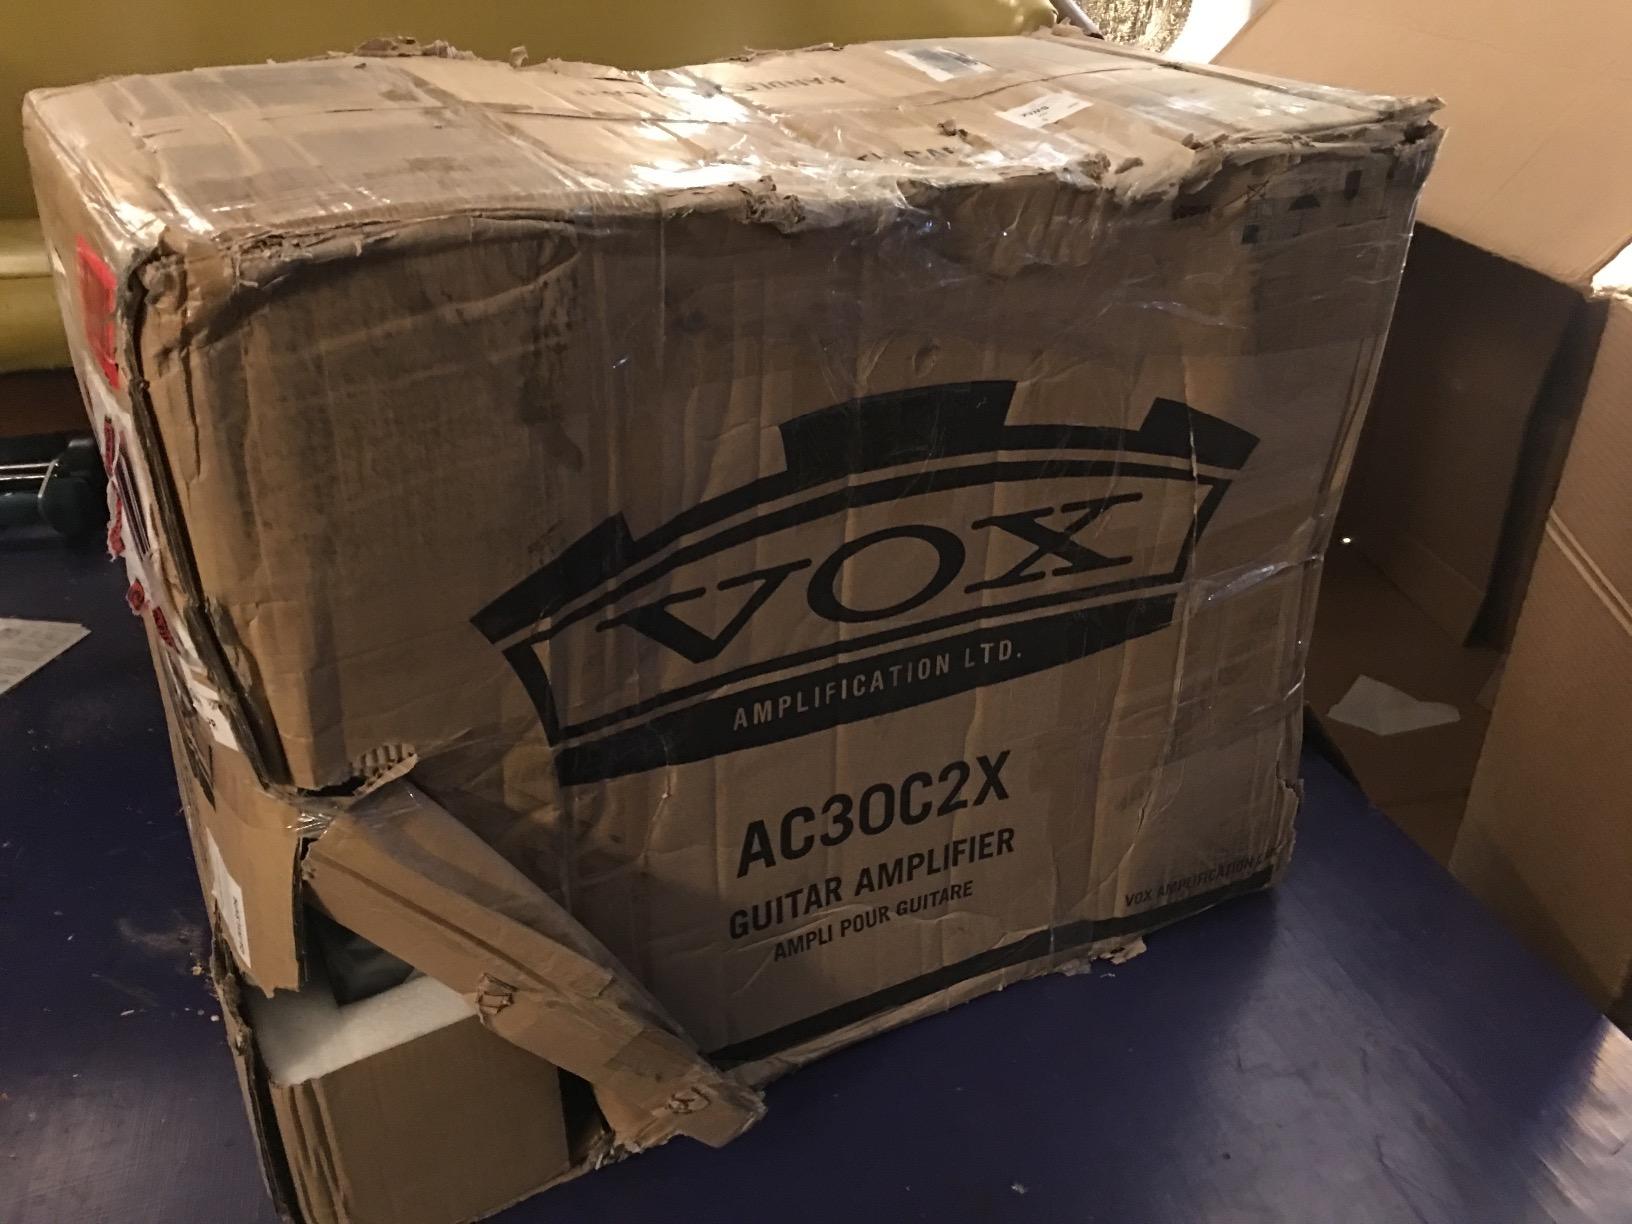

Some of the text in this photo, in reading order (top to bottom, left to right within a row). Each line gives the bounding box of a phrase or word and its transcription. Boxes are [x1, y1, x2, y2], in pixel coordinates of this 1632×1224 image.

[596, 493, 1142, 664] VOX
[733, 640, 1023, 731] AMPLIFICATION LTD.
[737, 750, 1011, 878] AC30C2X
[729, 827, 1015, 940] GUITAR AMPLIFIER
[773, 880, 974, 962] AMPLI POUR GUITARE
[1125, 889, 1152, 906] VOX
